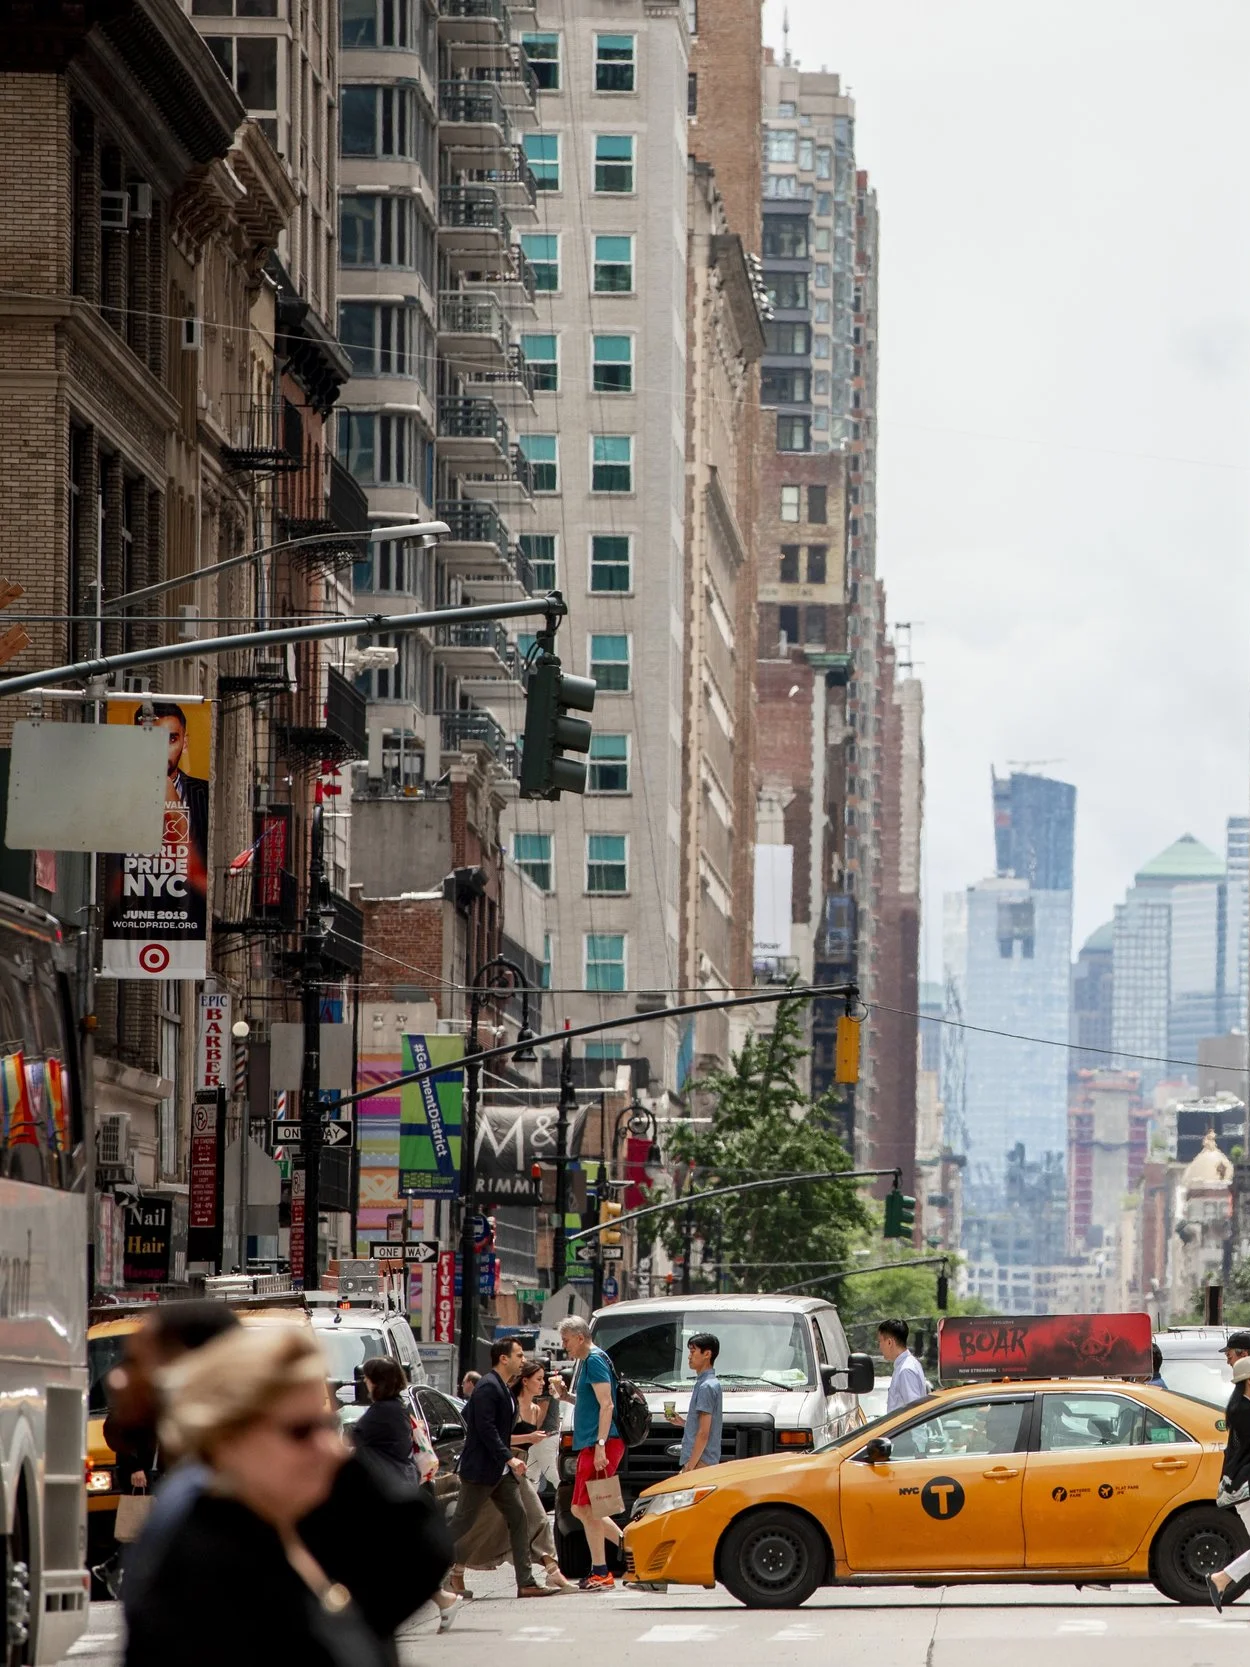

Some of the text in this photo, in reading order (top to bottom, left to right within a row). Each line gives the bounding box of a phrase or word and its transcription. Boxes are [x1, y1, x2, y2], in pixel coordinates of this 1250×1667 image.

[124, 858, 188, 874] PRIDE
[124, 874, 188, 898] NYC
[113, 921, 198, 929] WORLDPRIDE.ORG
[123, 911, 188, 920] JUNE 2019
[201, 995, 228, 1007] EPIC
[204, 1008, 223, 1087] BARBER
[413, 1043, 448, 1158] #GamentDistrict
[284, 1129, 341, 1140] ON AY
[130, 1207, 166, 1226] Nail
[127, 1235, 165, 1254] Hair
[379, 1248, 429, 1257] ONE WAY
[439, 1254, 452, 1343] FIVE GUYS
[961, 1327, 1029, 1362] BOAR
[899, 1484, 955, 1515] NYC T
